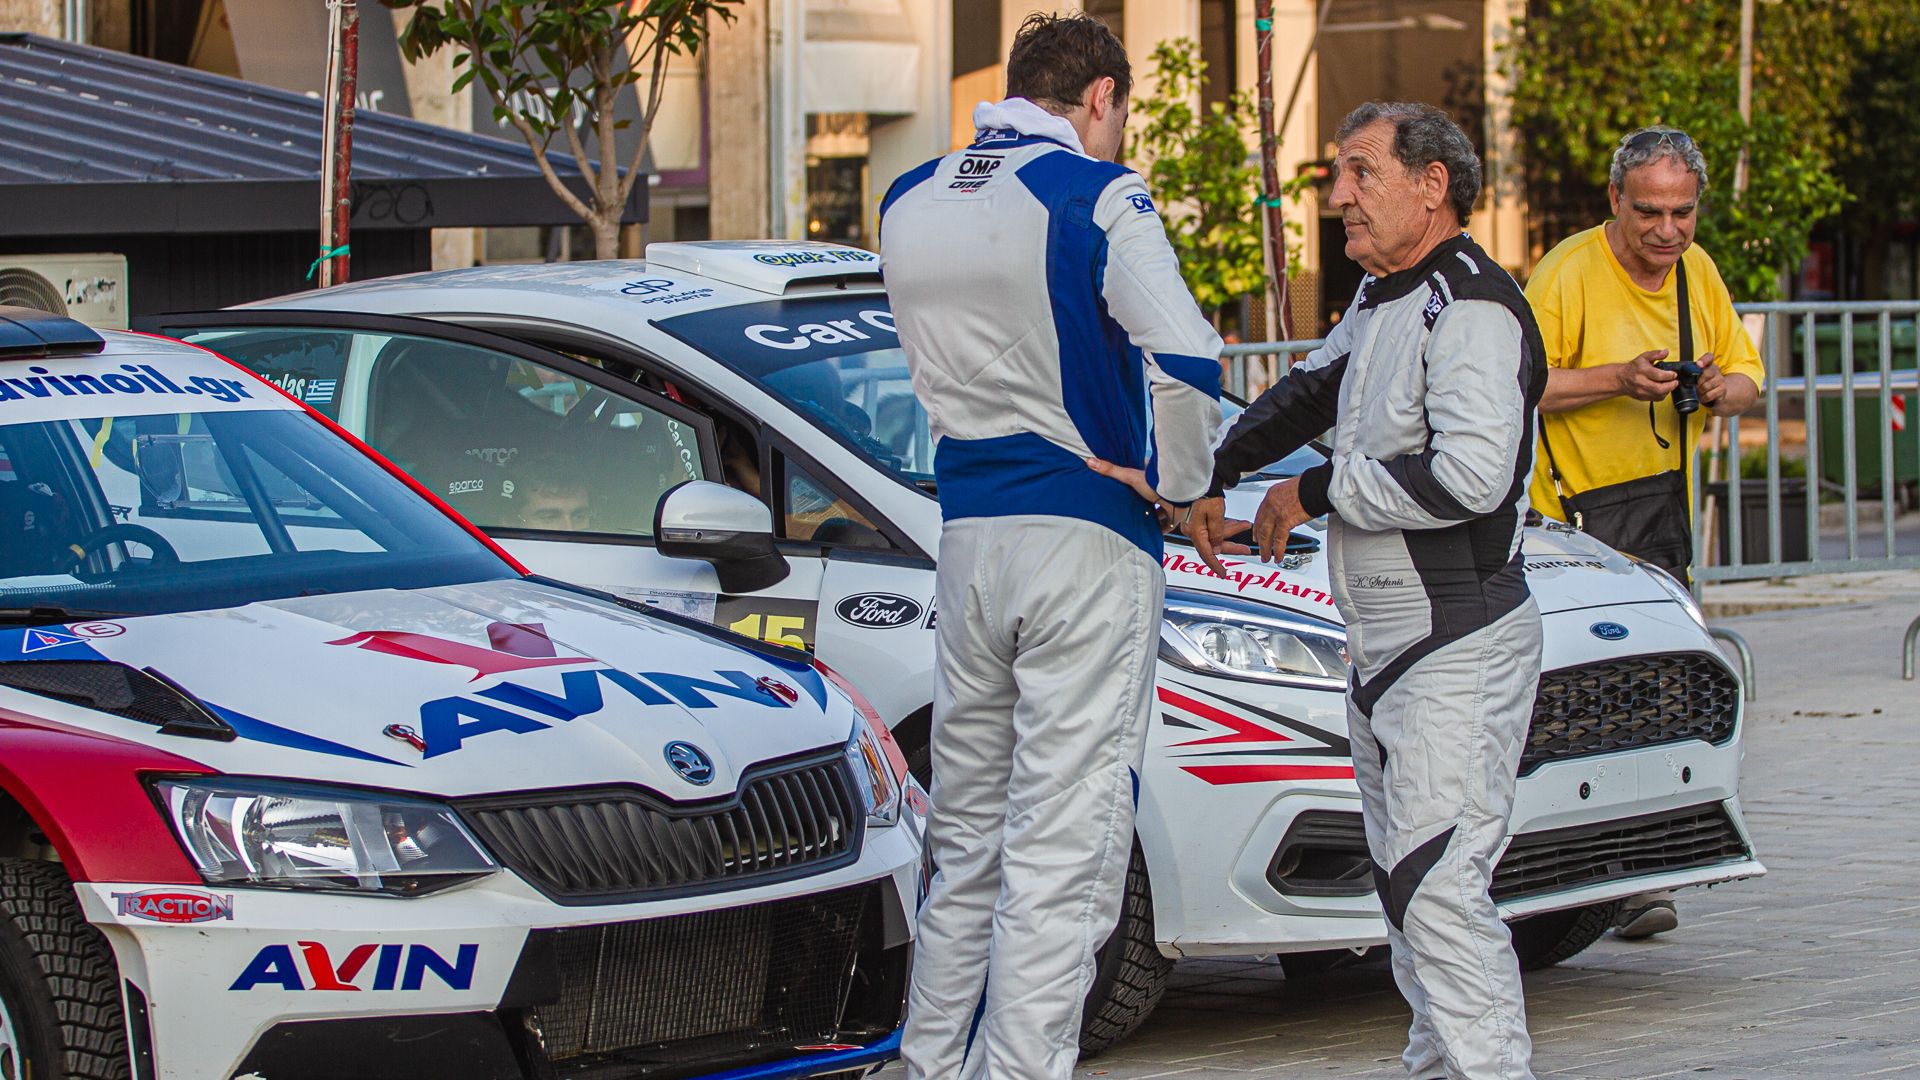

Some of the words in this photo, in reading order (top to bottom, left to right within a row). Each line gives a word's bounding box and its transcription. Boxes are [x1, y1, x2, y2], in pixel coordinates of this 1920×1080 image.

[959, 158, 1001, 175] OMP
[663, 293, 712, 304] PARTS
[744, 318, 871, 351] Car
[667, 419, 684, 447] Car
[449, 479, 484, 496] sparco
[850, 596, 908, 624] Ford
[730, 613, 805, 652] 15
[420, 668, 795, 761] AVIN
[111, 892, 234, 921] TRACTION
[228, 940, 480, 992] AVIN
